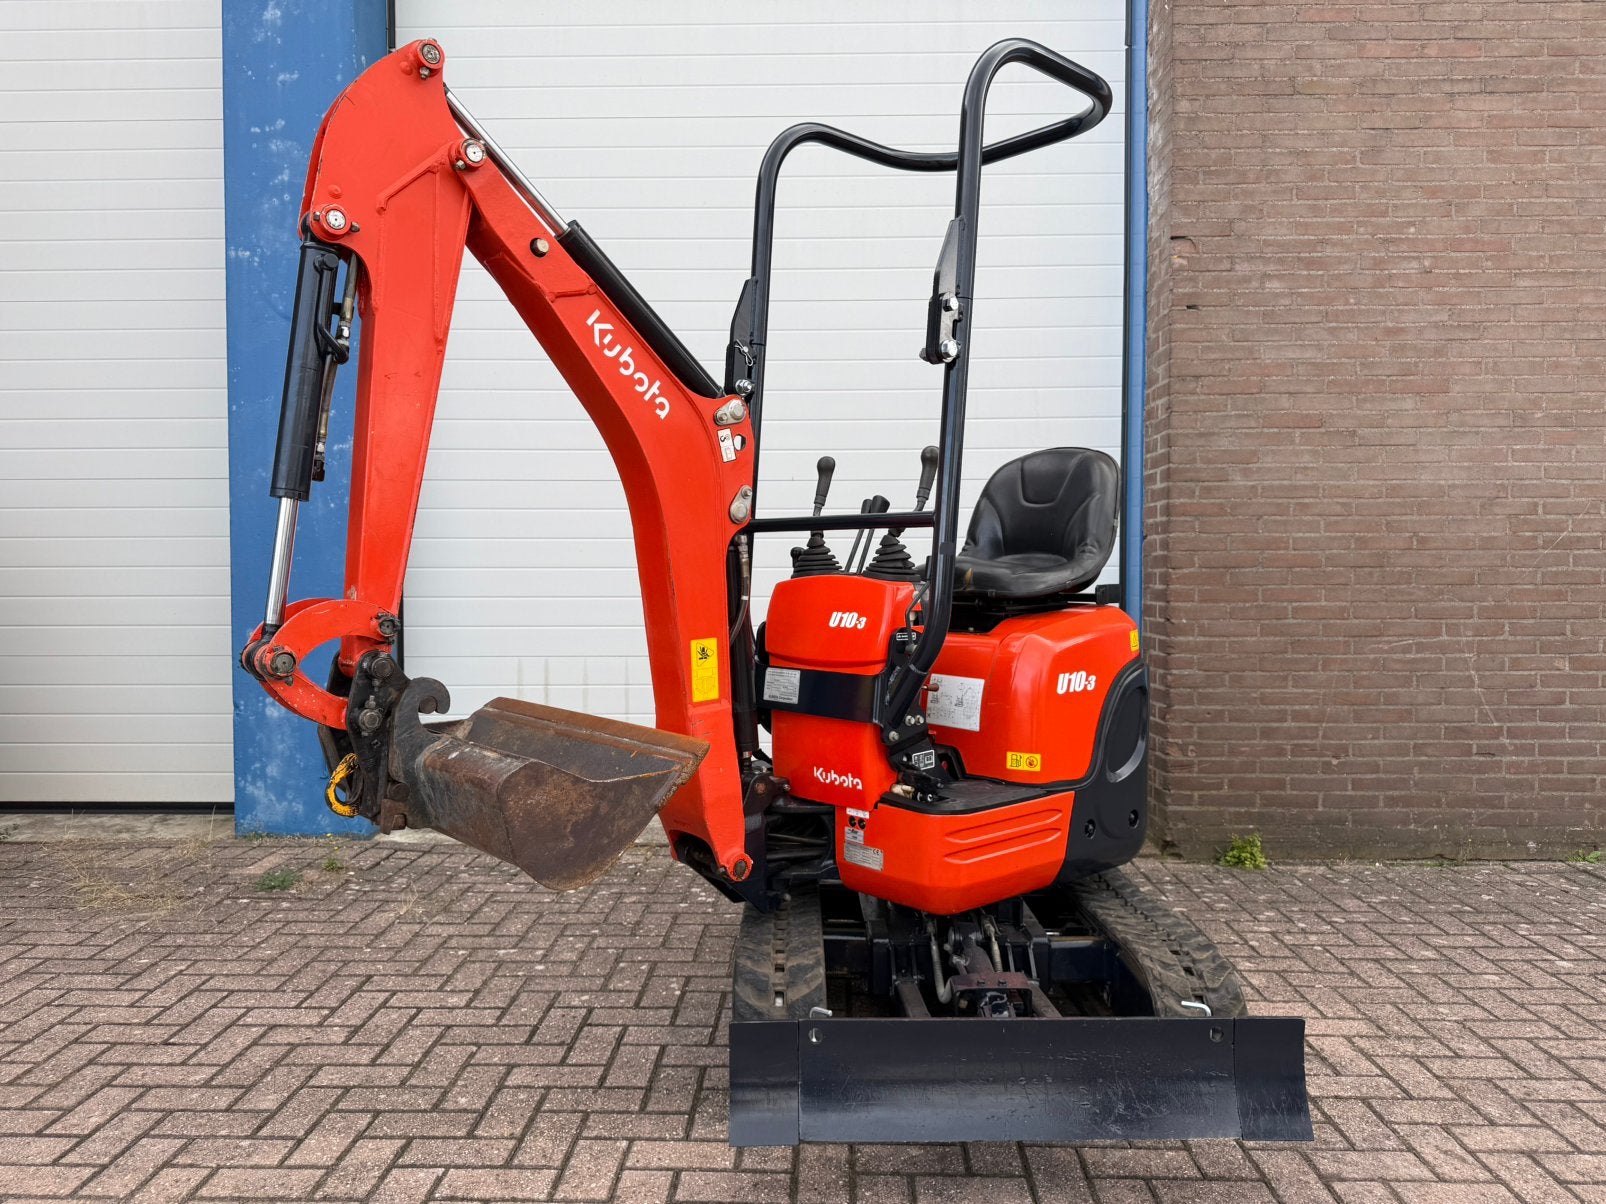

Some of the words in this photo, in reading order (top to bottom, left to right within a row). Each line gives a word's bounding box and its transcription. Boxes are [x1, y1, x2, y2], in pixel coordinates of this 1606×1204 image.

[586, 309, 670, 420] Kubota
[828, 611, 867, 629] U10-3
[1056, 670, 1097, 694] U10-3
[813, 766, 863, 790] Kubota
